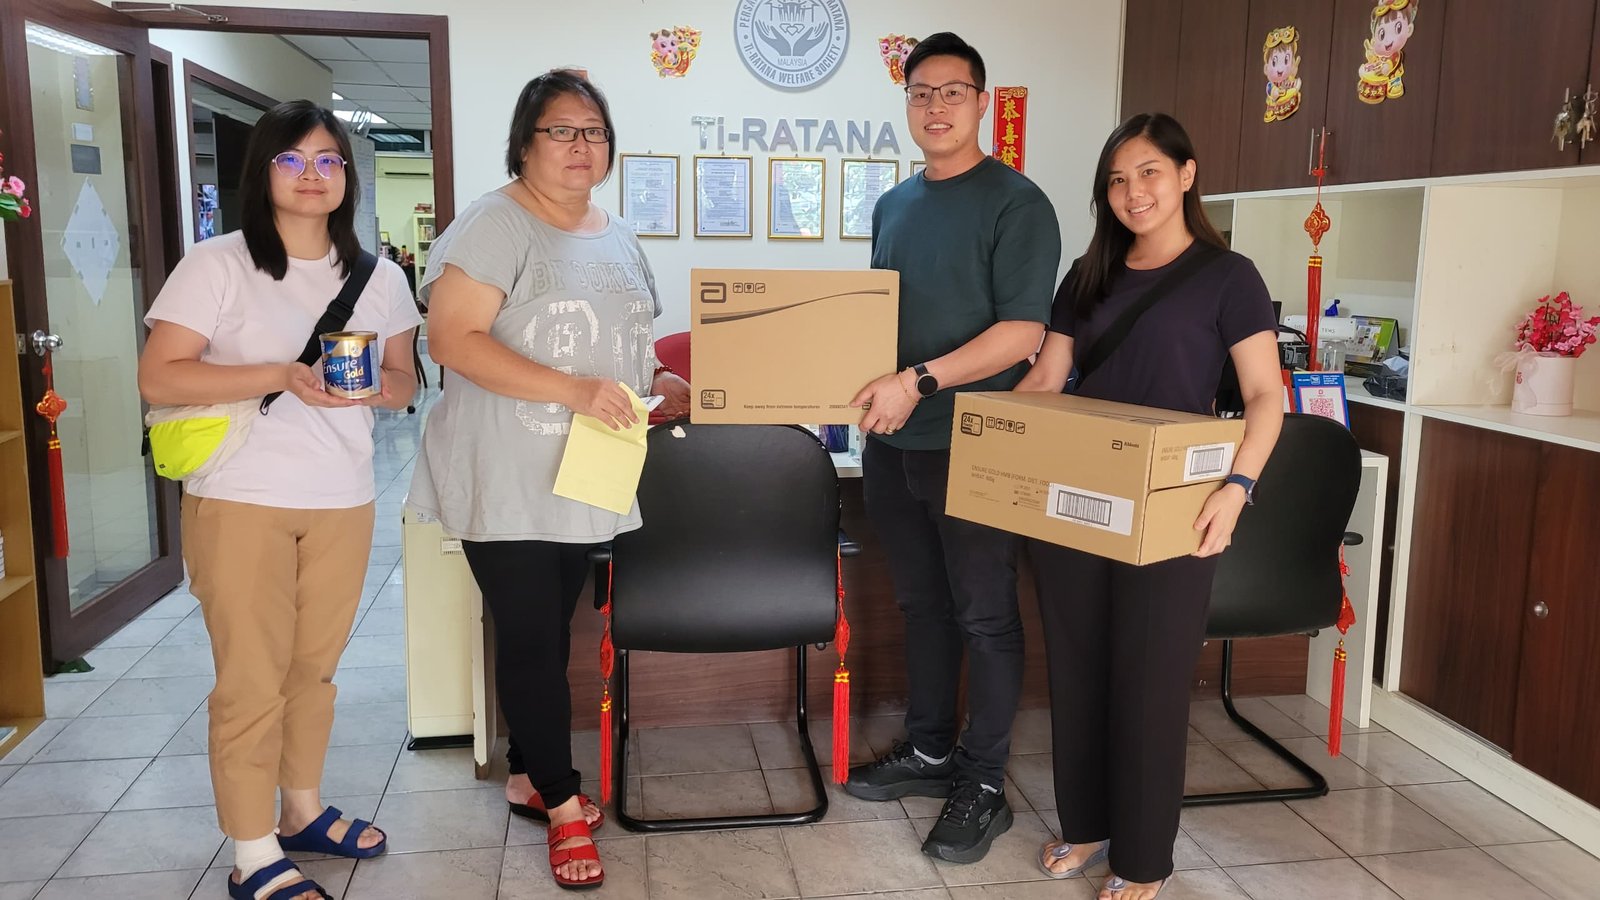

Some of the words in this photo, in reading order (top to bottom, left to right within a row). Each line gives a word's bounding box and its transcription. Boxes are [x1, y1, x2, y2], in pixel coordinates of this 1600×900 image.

[744, 42, 777, 80] TI-RATANA
[779, 70, 815, 84] WELFARE
[815, 44, 841, 75] SOCIETY
[777, 58, 807, 66] MALAYSIA
[691, 115, 901, 155] Ti-RATANA
[323, 359, 358, 374] Ensure
[344, 366, 364, 380] Gold
